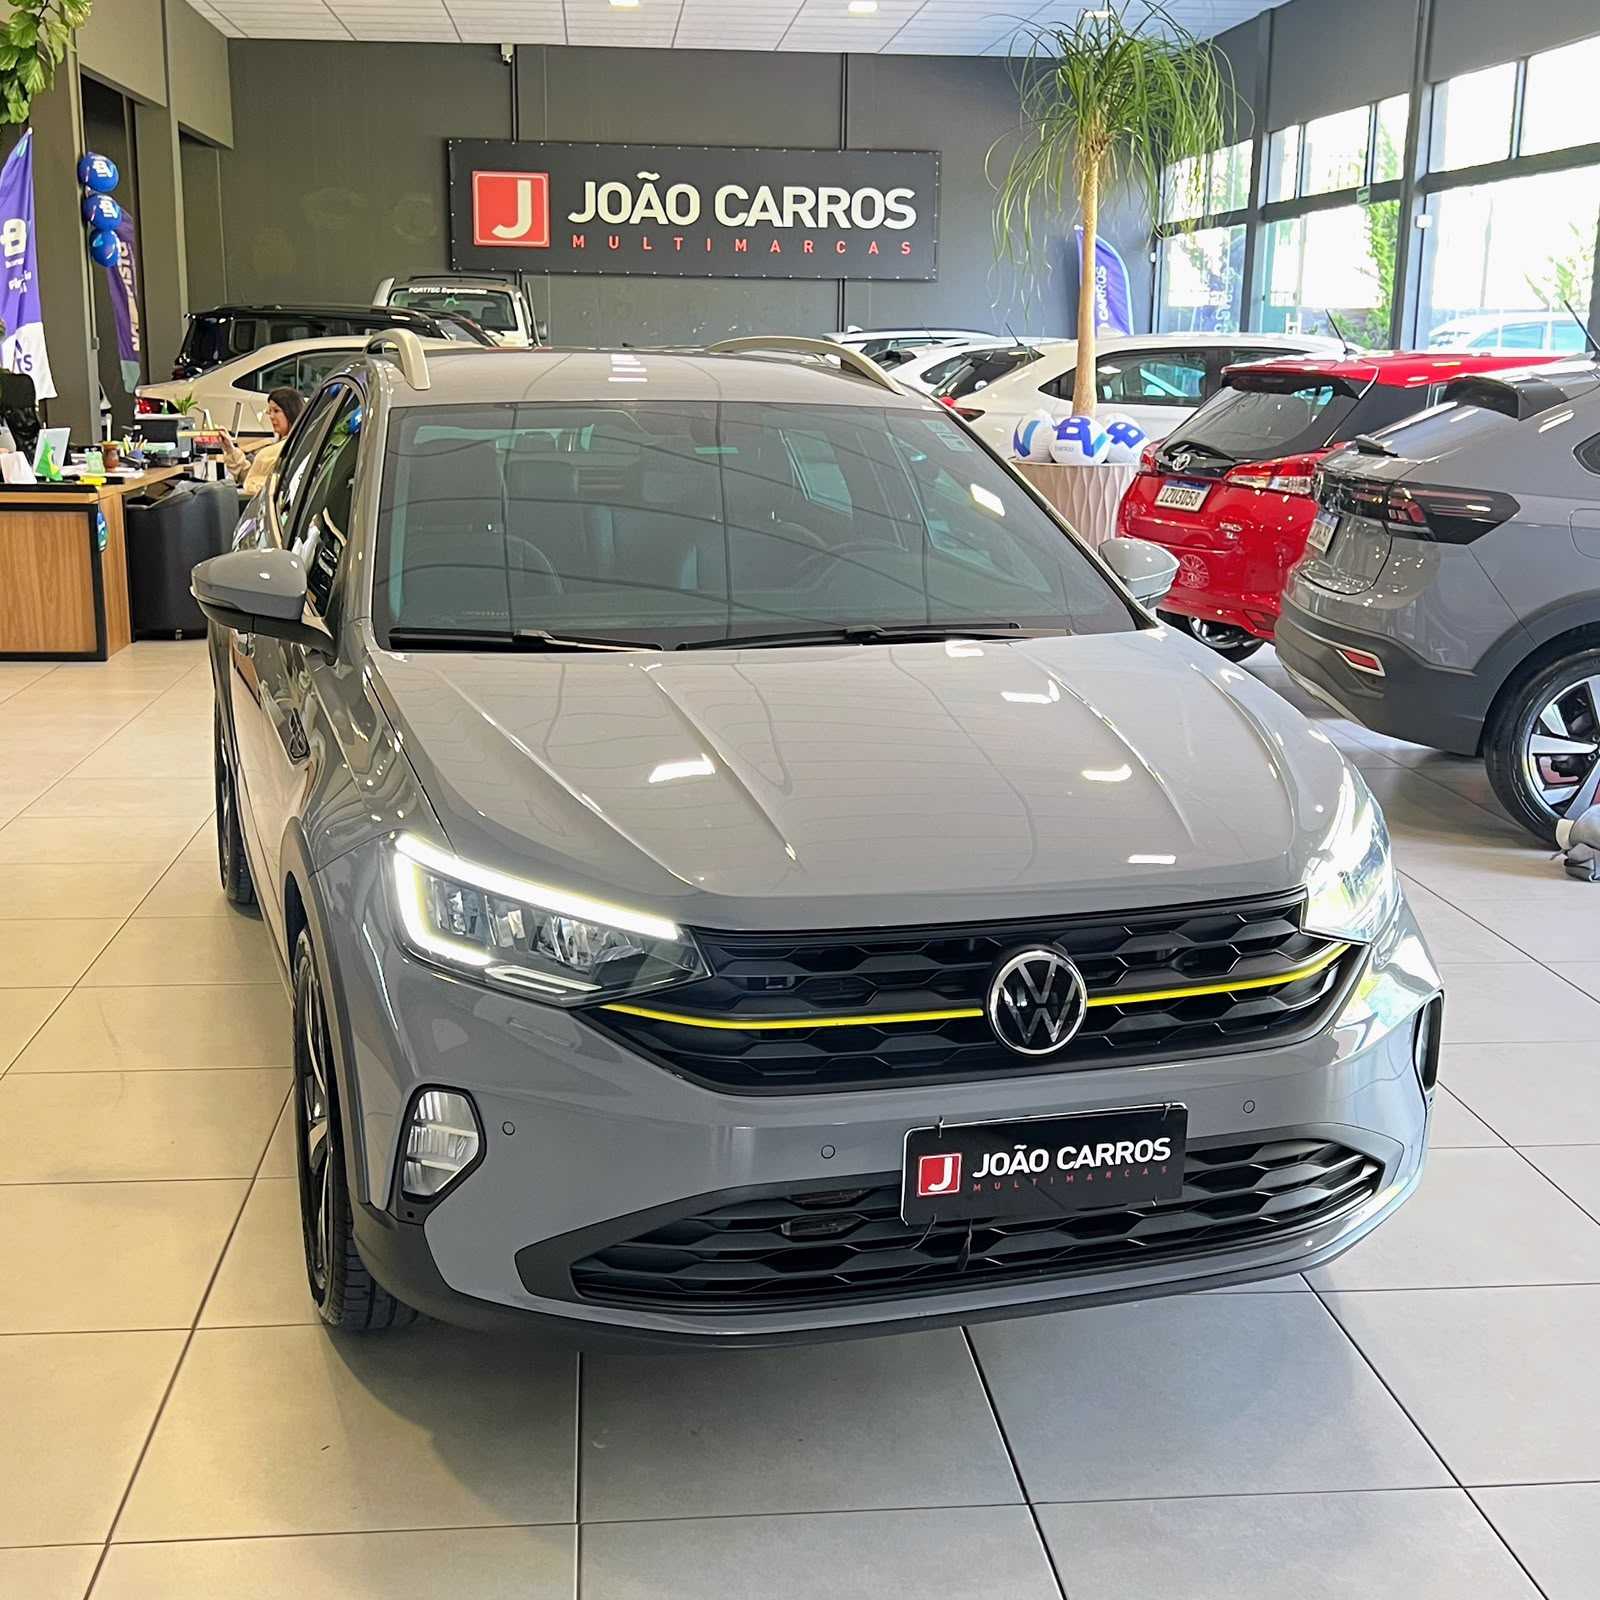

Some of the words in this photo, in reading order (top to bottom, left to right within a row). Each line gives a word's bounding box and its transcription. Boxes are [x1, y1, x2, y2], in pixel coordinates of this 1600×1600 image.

[567, 171, 701, 226] JOÃO
[714, 184, 917, 230] CARROS
[572, 234, 912, 255] MULTIMARCAS
[972, 1144, 1050, 1179] JOÃO
[1056, 1137, 1172, 1170] CARROS
[972, 1165, 1168, 1192] MULTIMARCAS
